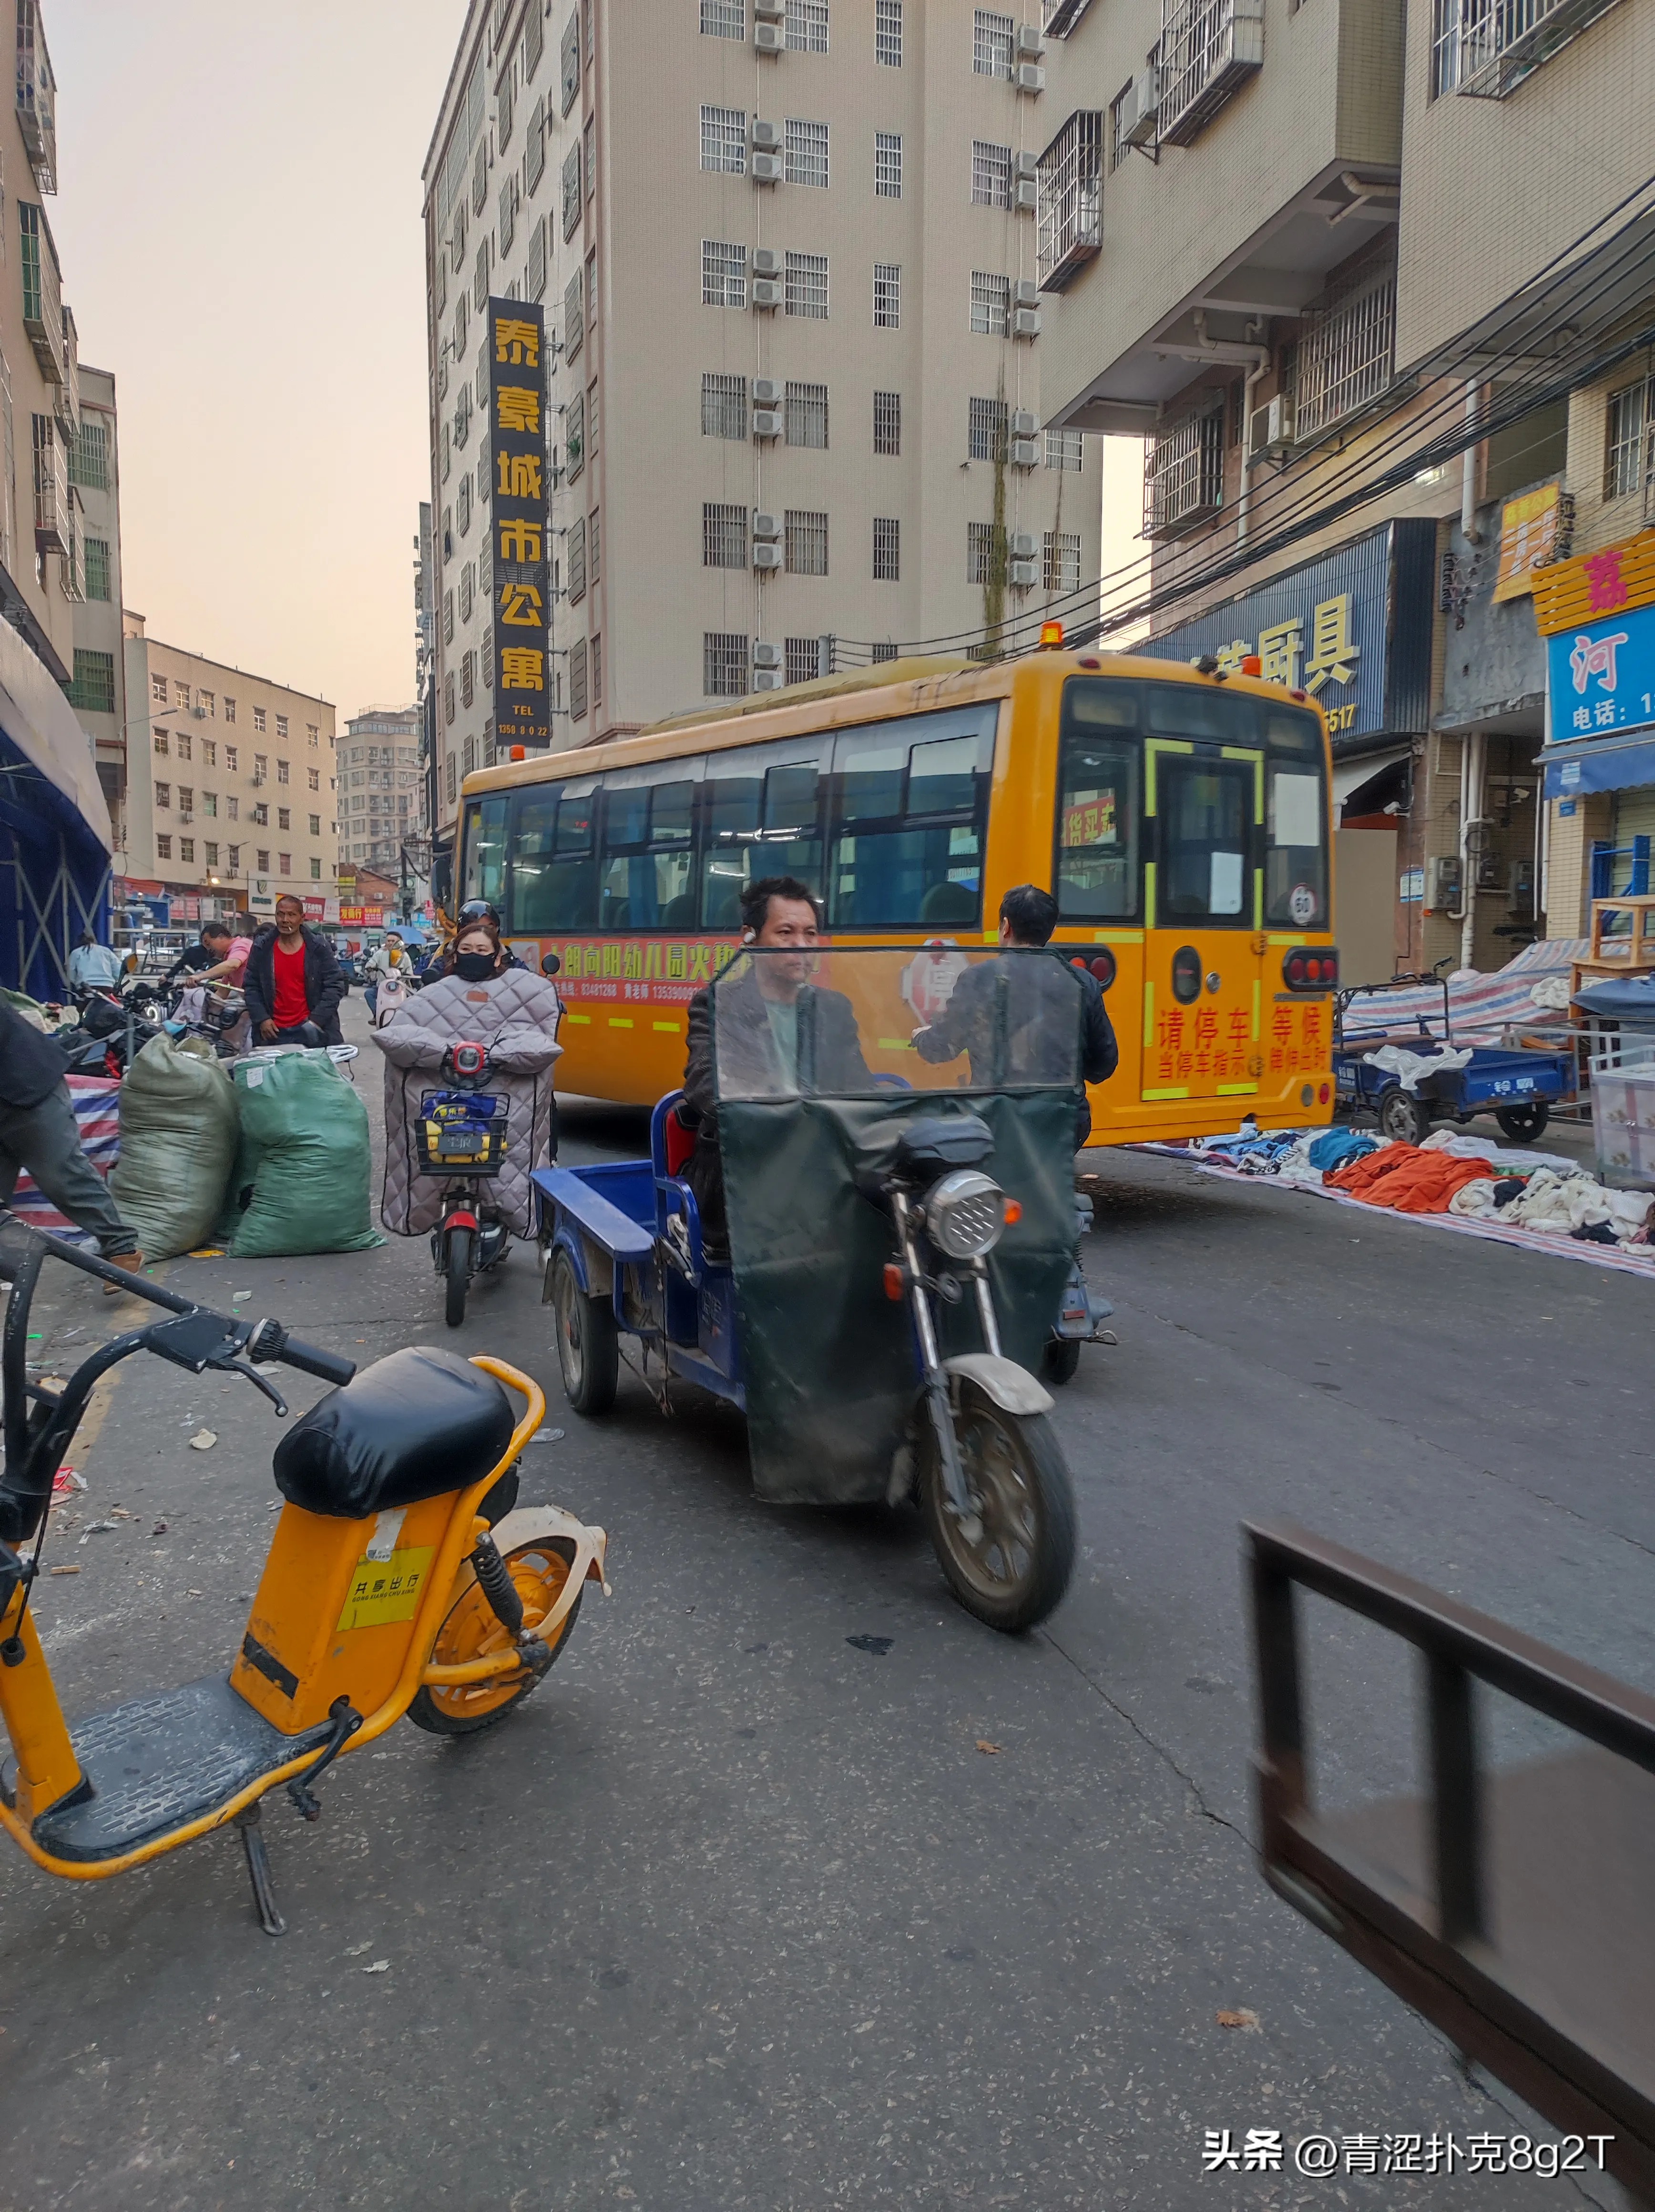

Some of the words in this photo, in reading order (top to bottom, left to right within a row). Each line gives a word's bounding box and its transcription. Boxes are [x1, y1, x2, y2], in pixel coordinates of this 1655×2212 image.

[495, 317, 542, 691] 泰豪城市公寓
[1190, 593, 1360, 694] 厨具
[1570, 632, 1628, 695] 河
[512, 705, 534, 716] TEL
[1640, 693, 1655, 714] 1
[1158, 1006, 1321, 1050] 请停车等候
[352, 1594, 369, 1603] GONG
[369, 1592, 388, 1600] XIANG
[401, 1587, 415, 1596] XING
[354, 1574, 420, 1596] 共享出行
